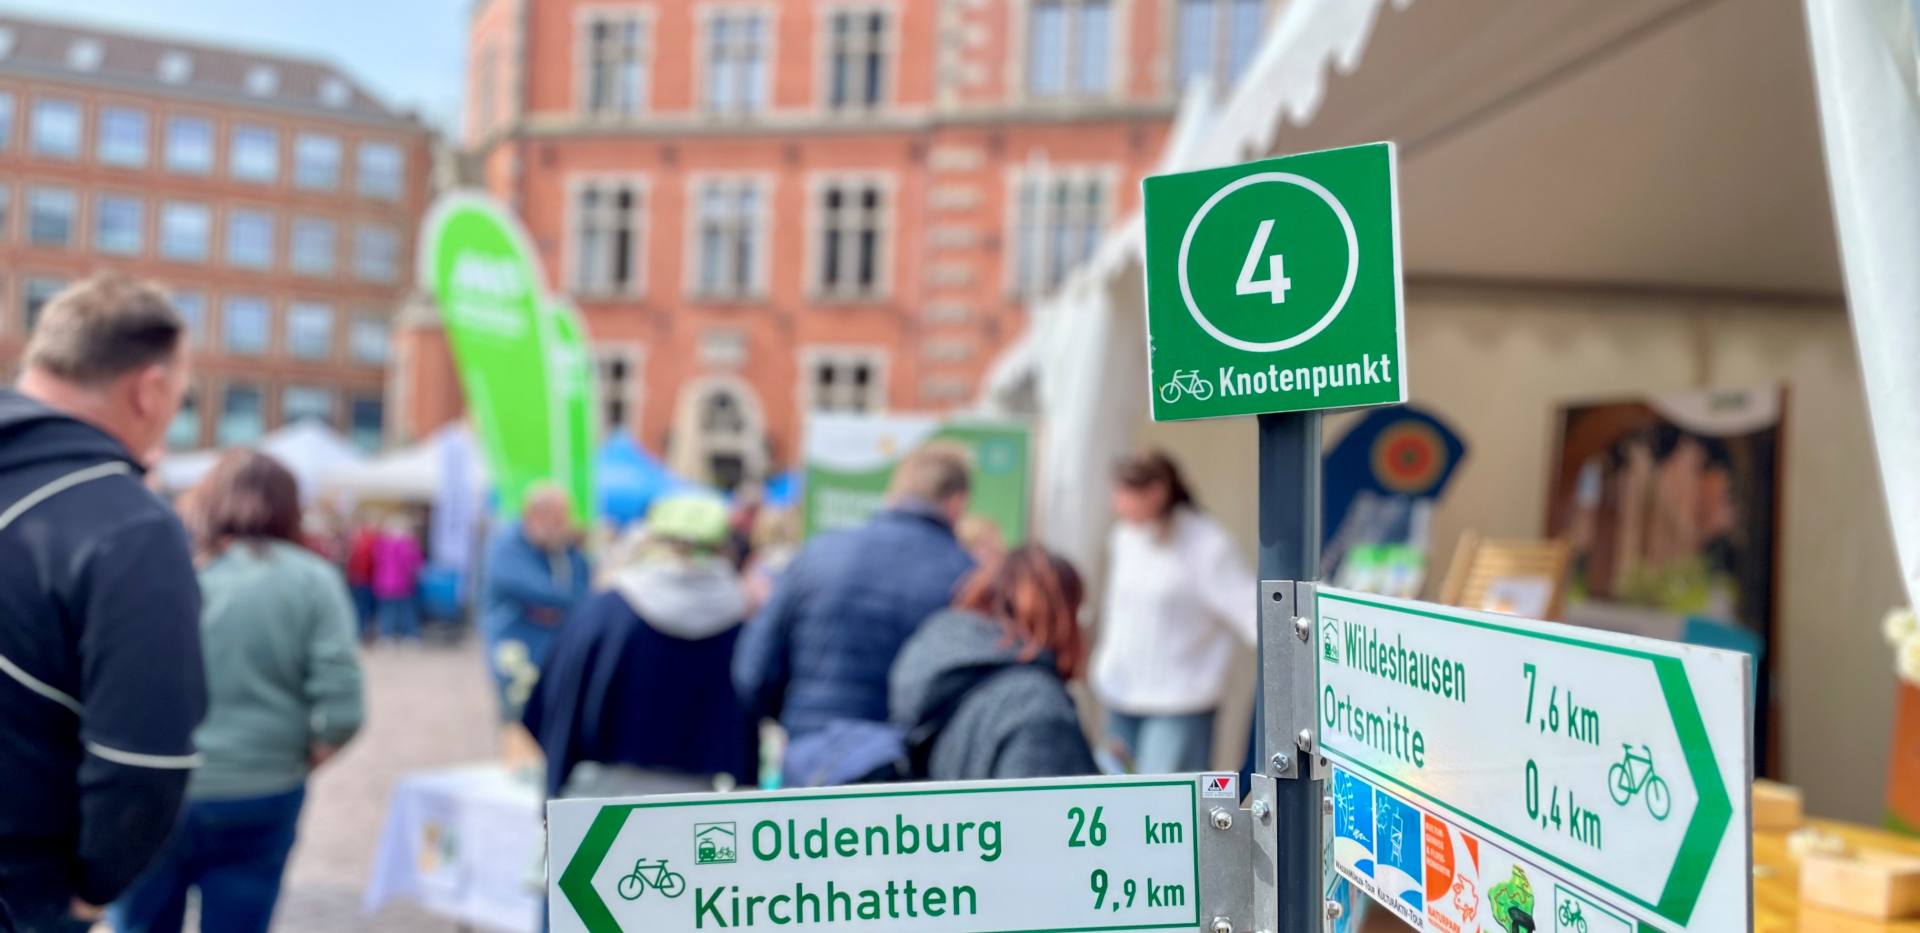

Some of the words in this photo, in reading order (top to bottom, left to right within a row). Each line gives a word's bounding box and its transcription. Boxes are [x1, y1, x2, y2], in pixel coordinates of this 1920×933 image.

[1235, 219, 1292, 304] 4
[1219, 353, 1392, 398] Knotenpunkt
[1344, 621, 1467, 703] Wildeshausen
[1522, 662, 1560, 734] 7,6
[1566, 688, 1601, 747] km
[1323, 683, 1425, 769] Ortsmitte
[1525, 760, 1562, 831] 0,4
[1567, 791, 1603, 849] km
[751, 814, 1003, 864] Oldenburg
[1066, 804, 1109, 849] 26
[1144, 815, 1184, 848] km
[693, 880, 977, 929] Kirchhatten
[1089, 867, 1138, 914] 9,9
[1145, 878, 1186, 909] km
